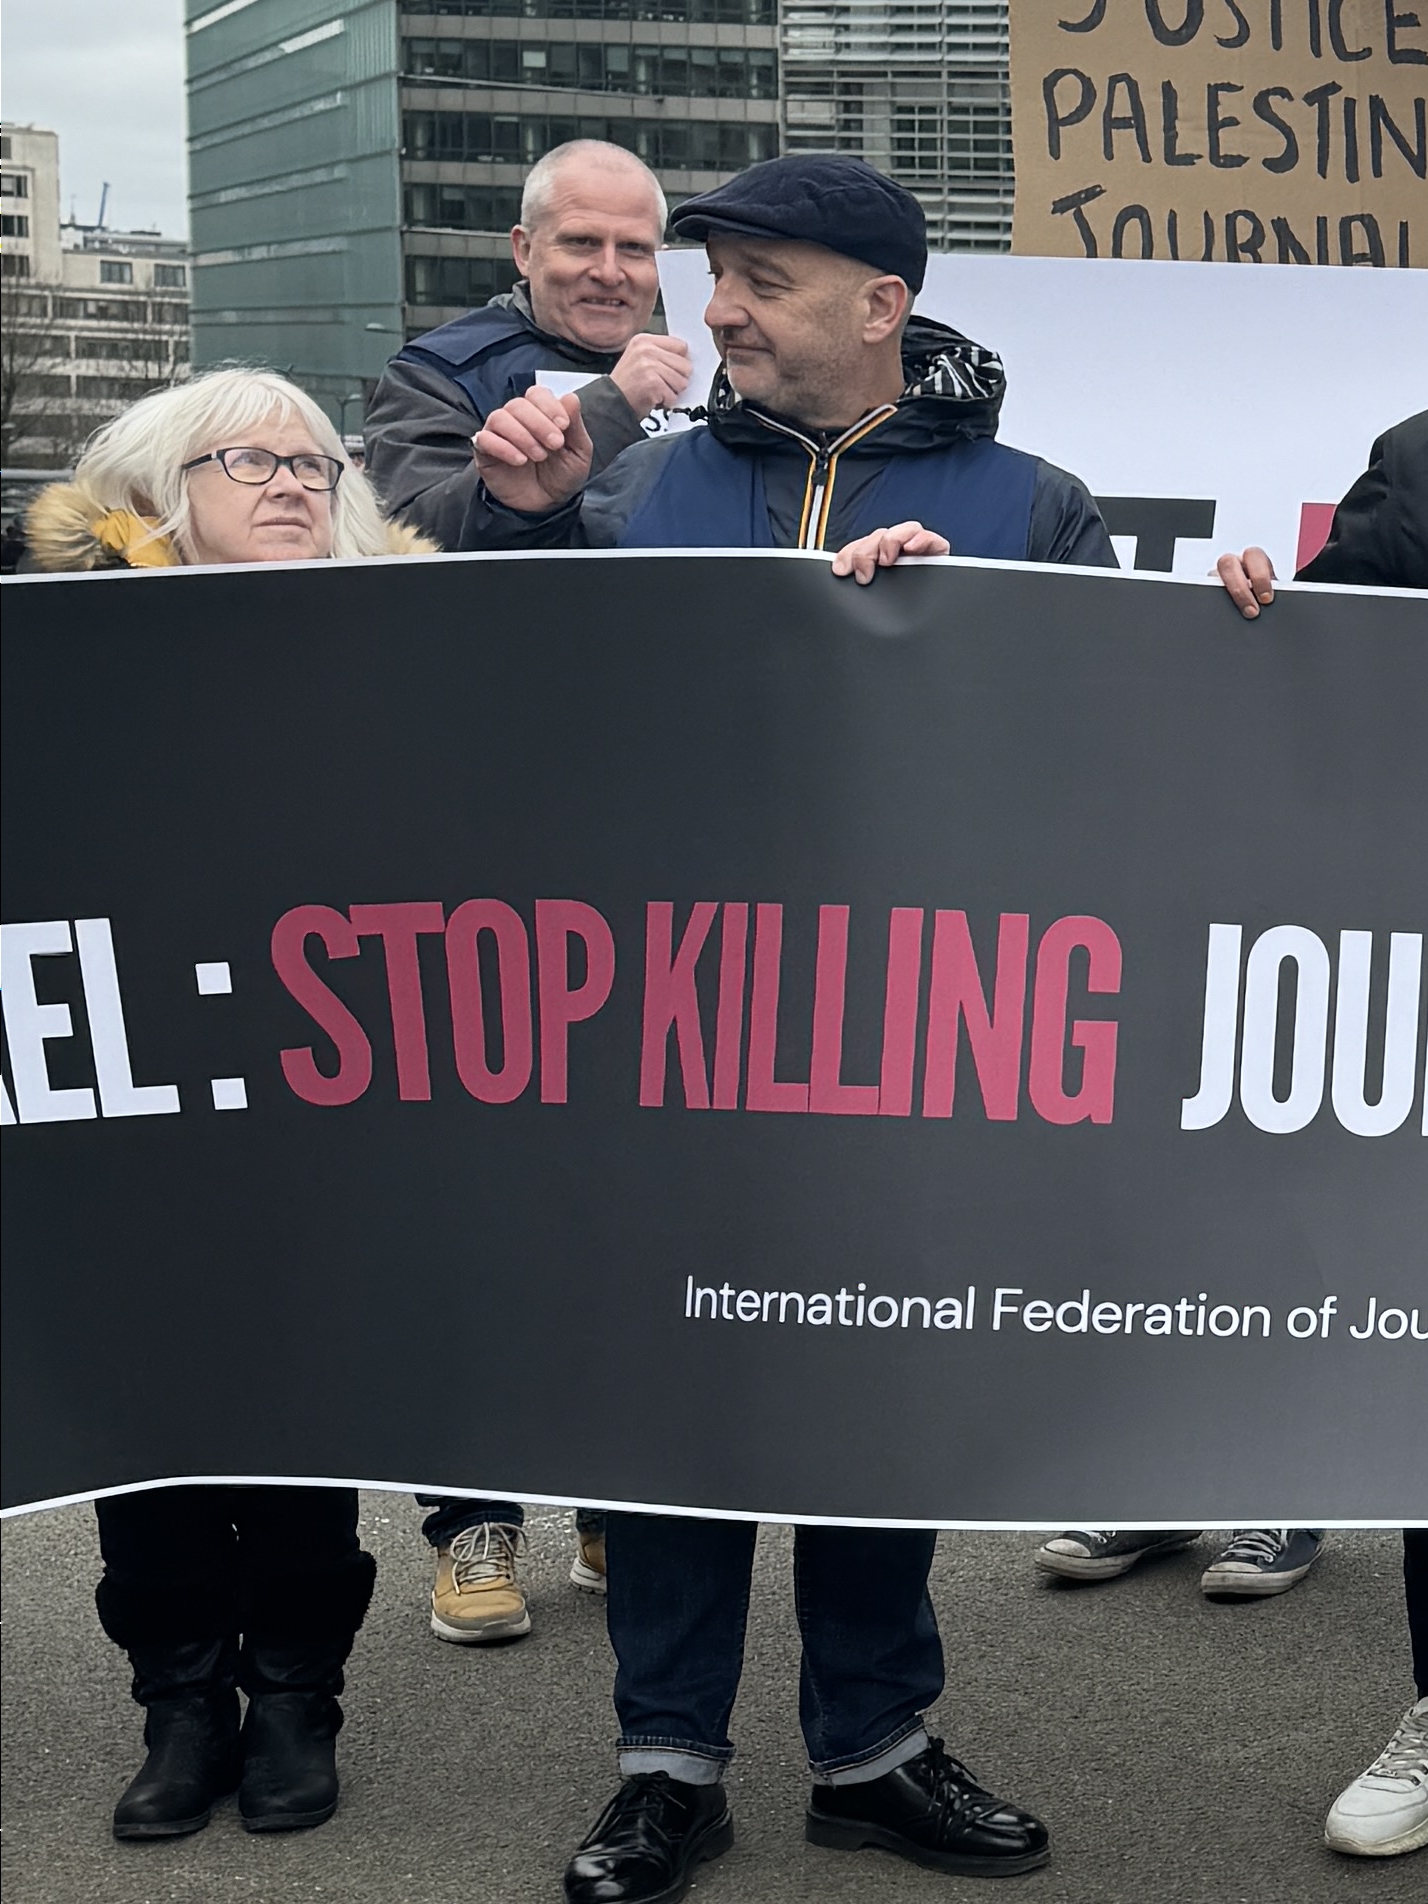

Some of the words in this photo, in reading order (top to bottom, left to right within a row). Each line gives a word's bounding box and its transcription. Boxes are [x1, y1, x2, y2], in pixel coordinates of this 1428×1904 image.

[0, 917, 181, 1126] EL
[271, 898, 616, 1107] STOP
[639, 901, 1123, 1125] KILLING
[683, 1274, 976, 1331] International
[993, 1287, 1270, 1338] Federation
[1286, 1296, 1337, 1339] of
